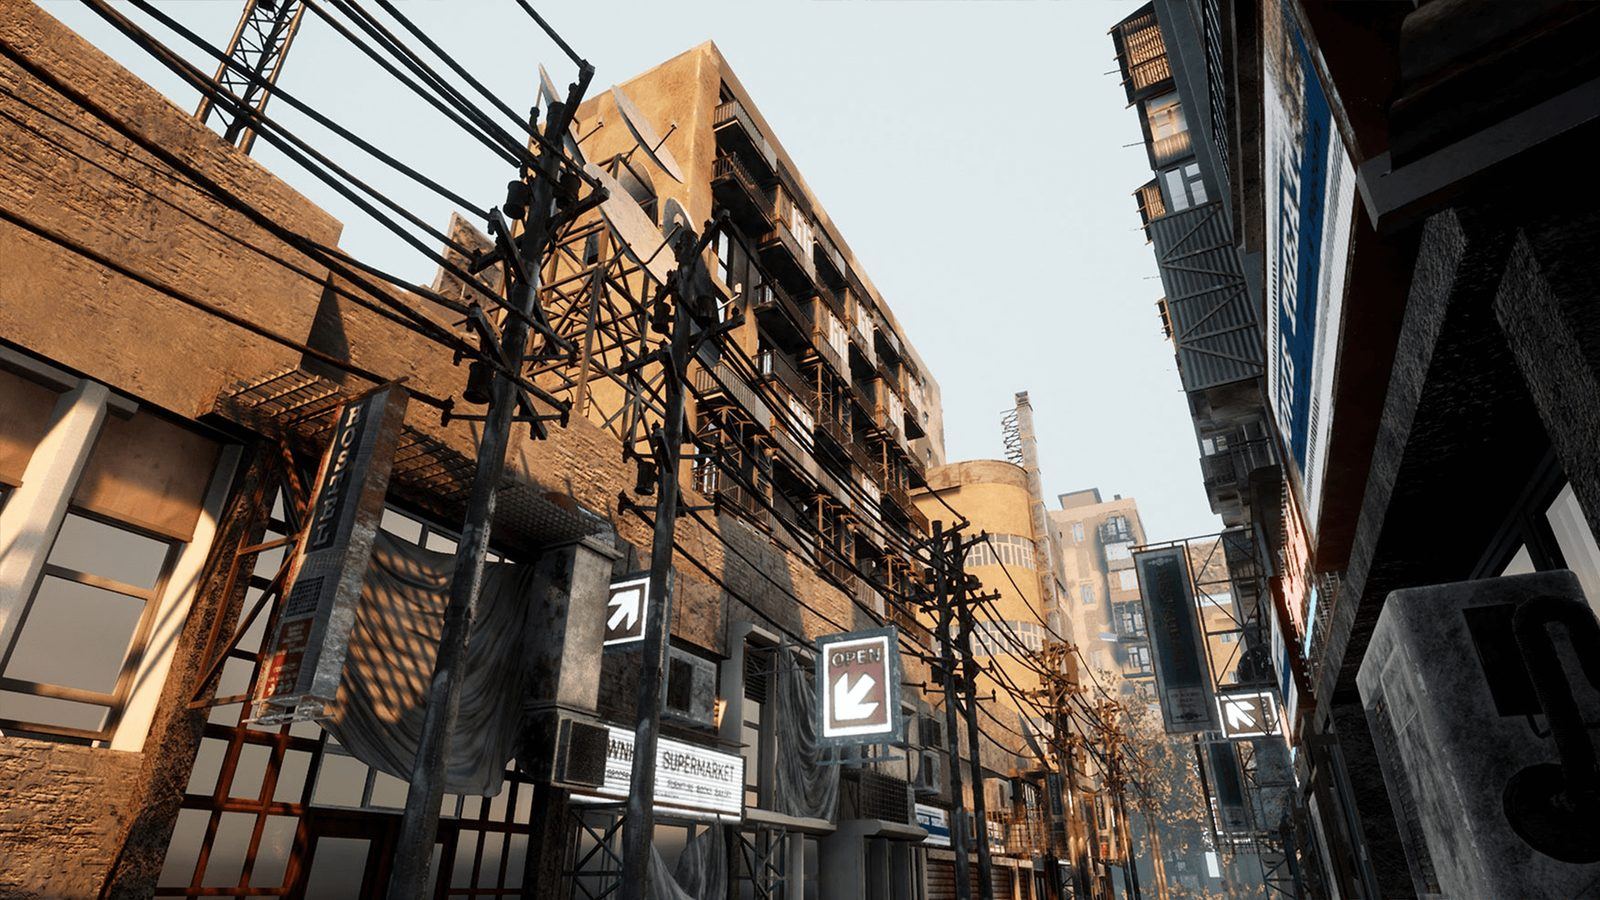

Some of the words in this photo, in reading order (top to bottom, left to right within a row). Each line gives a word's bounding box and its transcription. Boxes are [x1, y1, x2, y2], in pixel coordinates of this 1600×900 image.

[312, 403, 364, 546] HOSTEL
[831, 647, 881, 667] OPEN
[662, 751, 735, 782] SUPERMARKET
